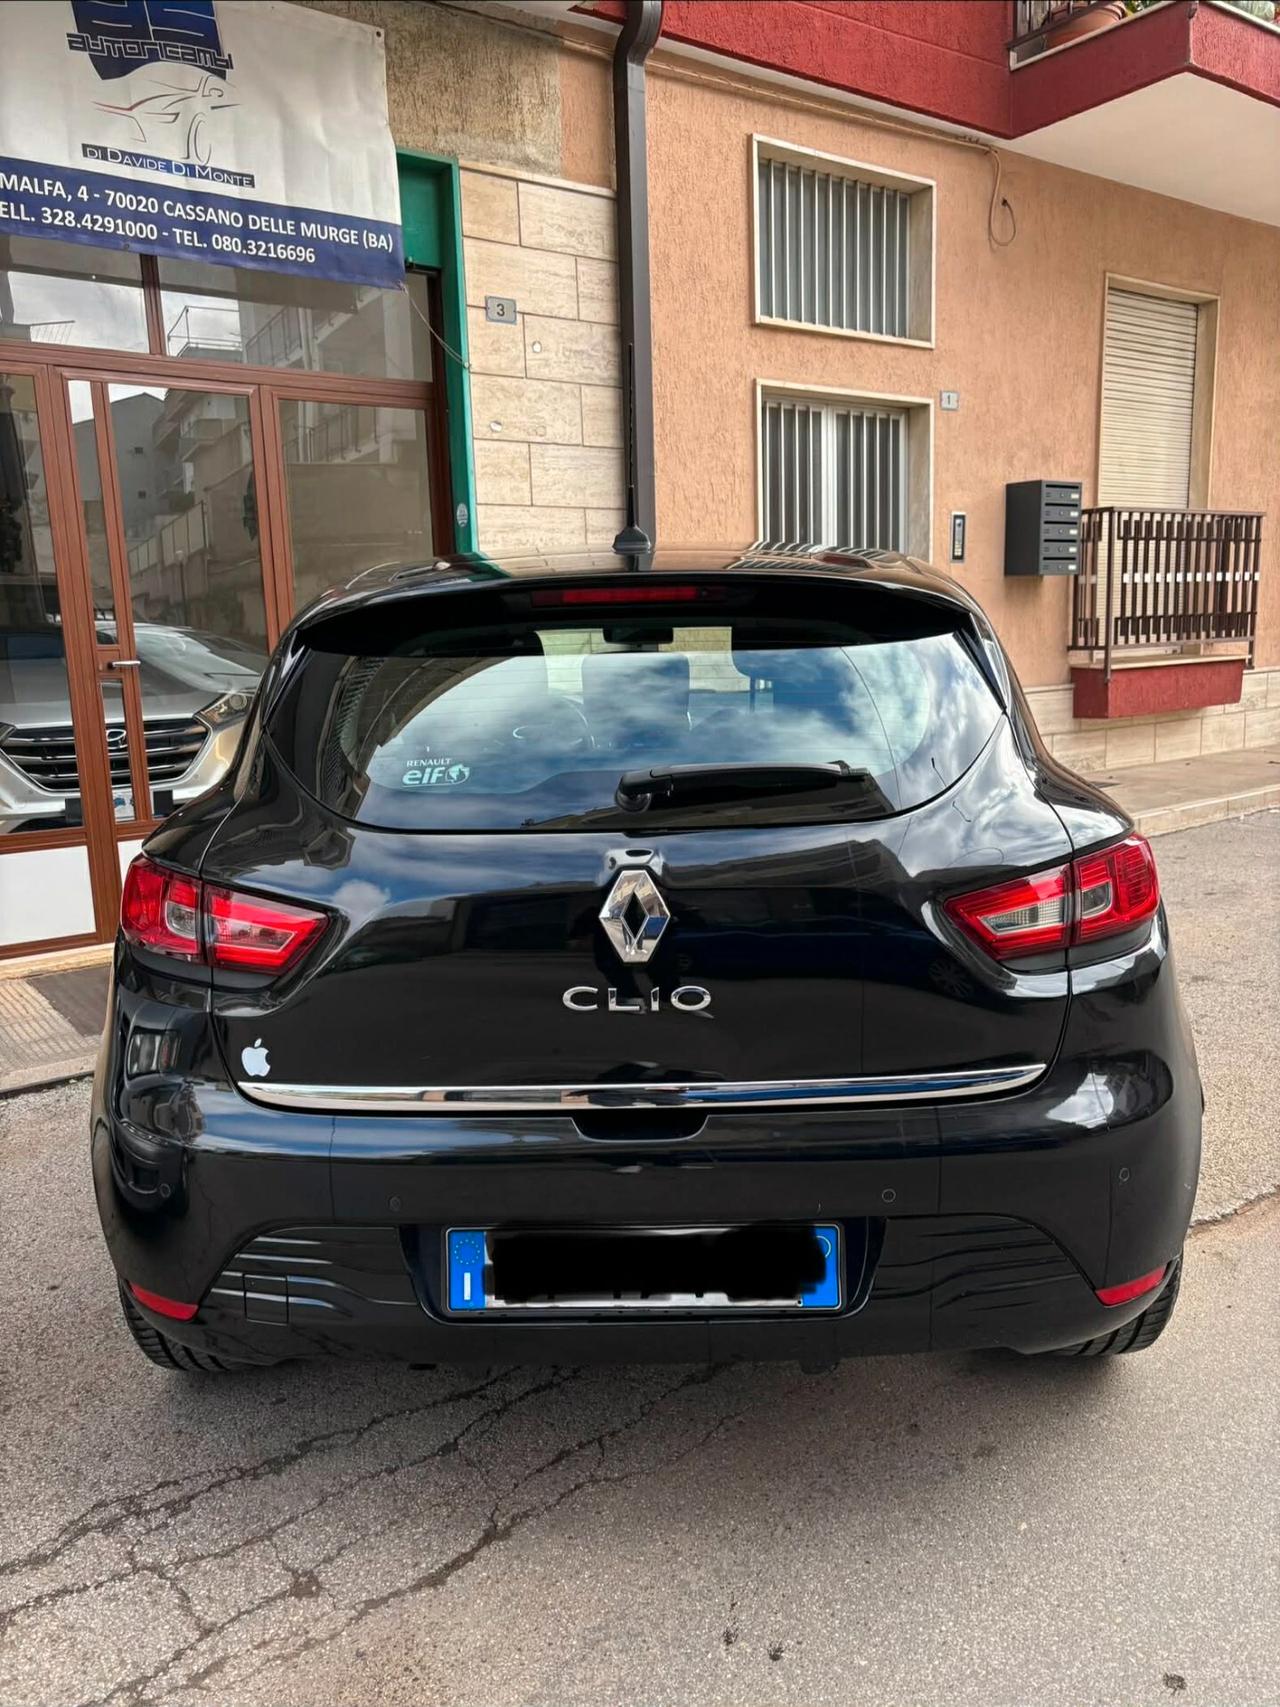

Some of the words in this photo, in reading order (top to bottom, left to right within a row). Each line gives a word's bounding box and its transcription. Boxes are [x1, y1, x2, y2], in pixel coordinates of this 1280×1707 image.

[77, 186, 89, 202] 4
[105, 190, 158, 214] 70020
[163, 201, 243, 228] CASSANO
[248, 214, 296, 236] DELLE
[301, 222, 359, 245] MURGE
[363, 229, 393, 253] (BA)
[41, 207, 158, 240] 328.4291000
[173, 228, 207, 248] TEL.
[212, 234, 316, 263] 080.3216696
[496, 303, 505, 317] 3
[406, 758, 451, 767] RENAULT
[402, 767, 445, 784] elf
[562, 985, 712, 1012] CLIO
